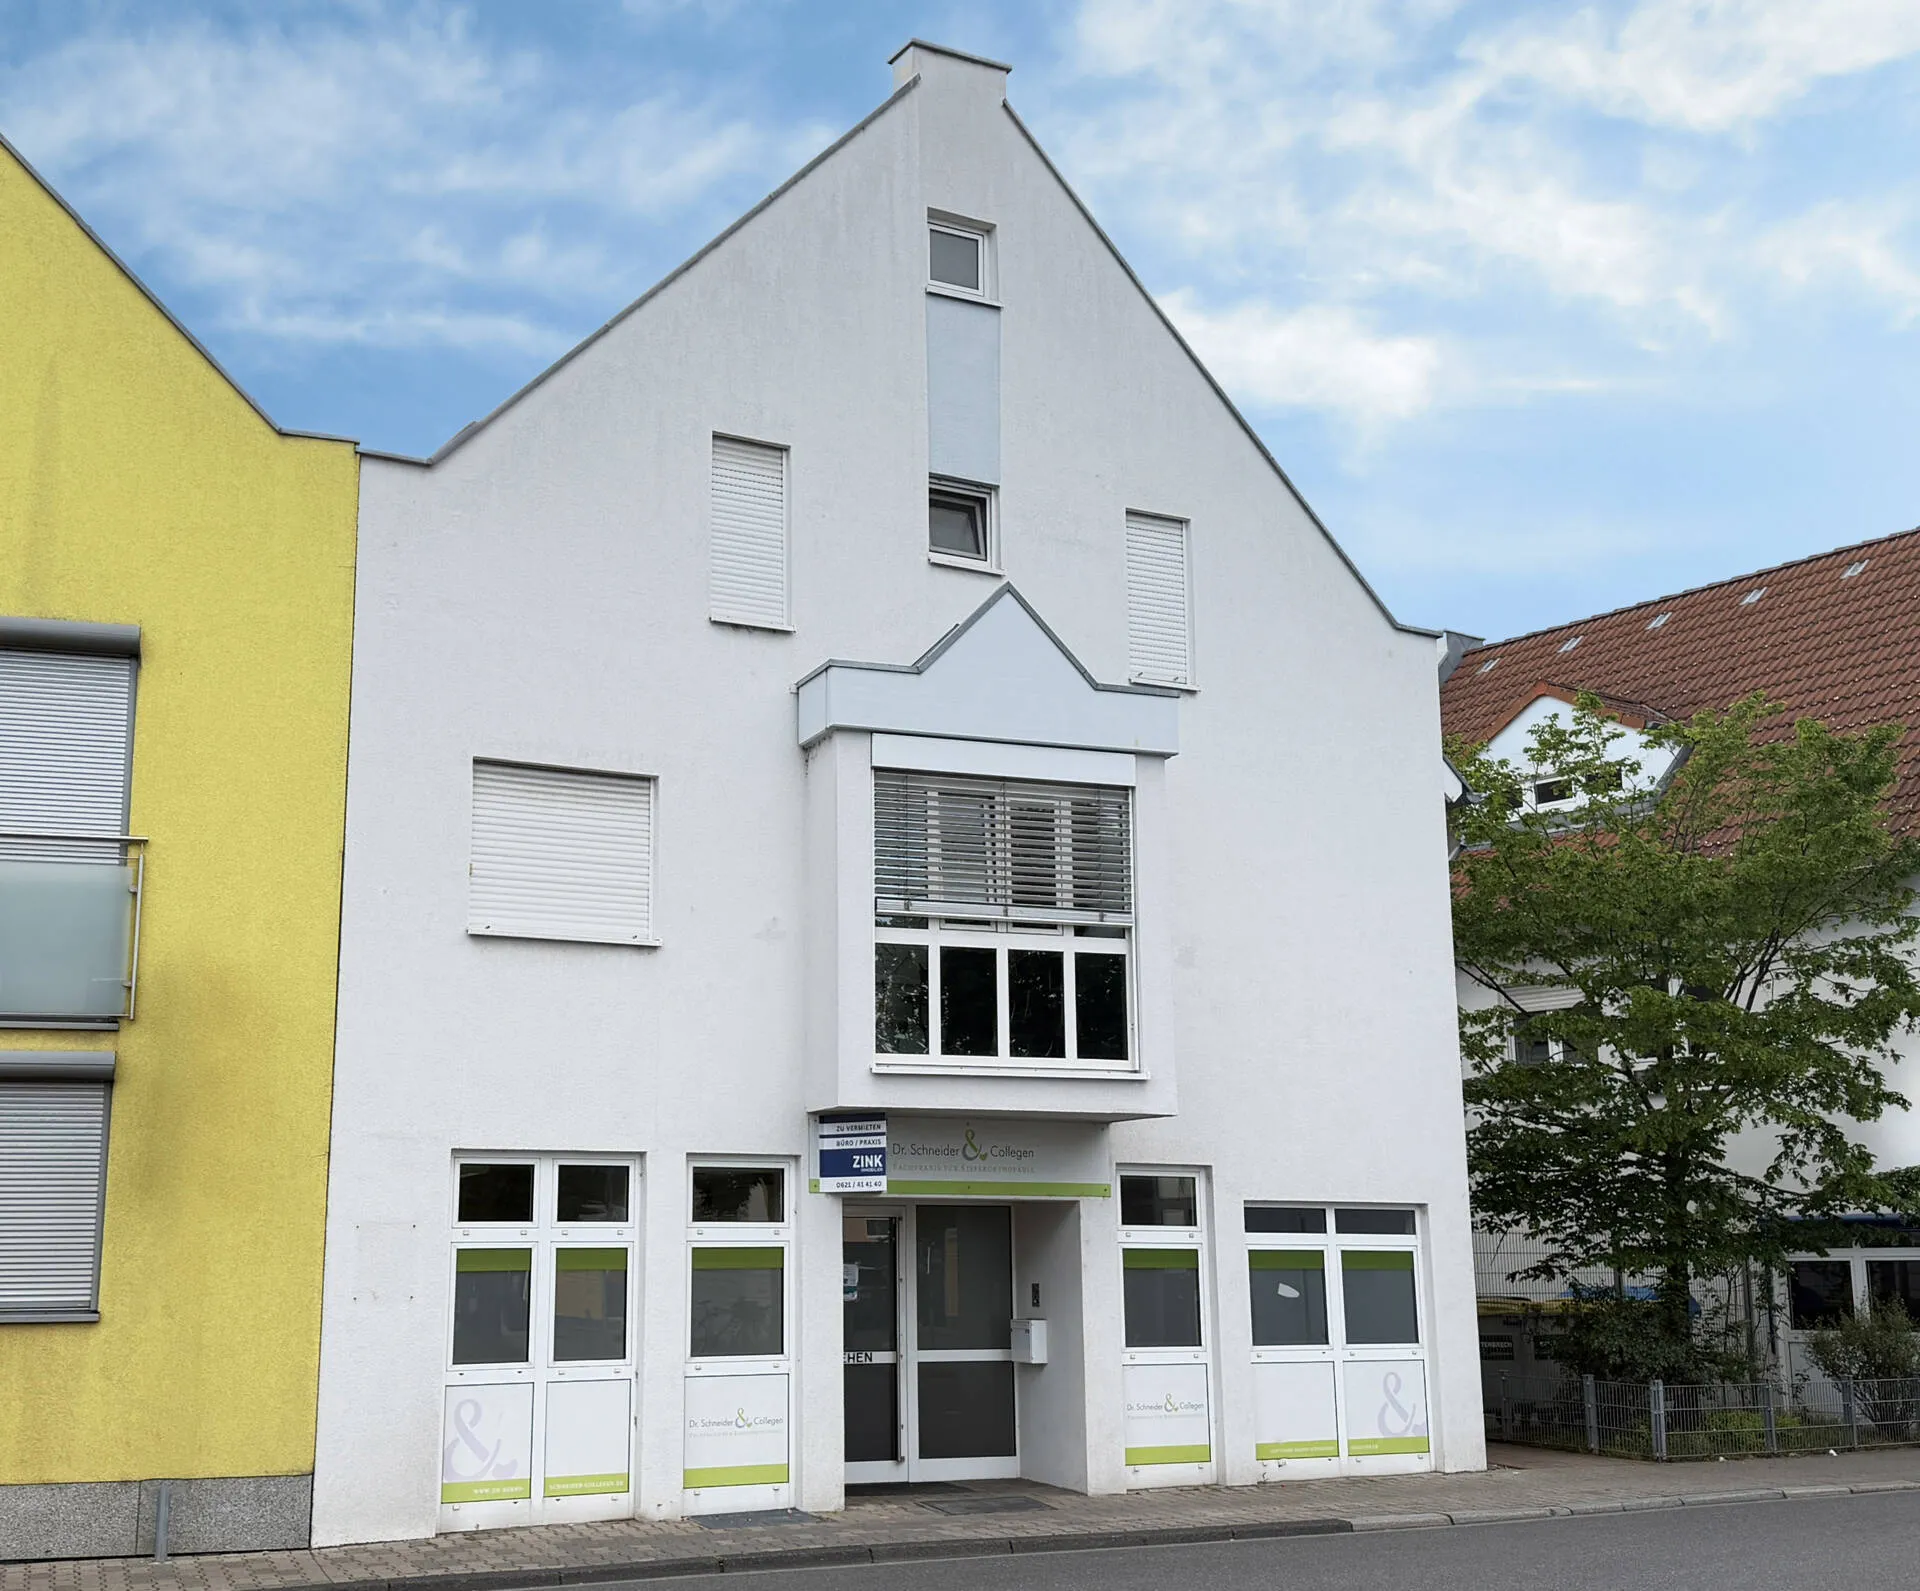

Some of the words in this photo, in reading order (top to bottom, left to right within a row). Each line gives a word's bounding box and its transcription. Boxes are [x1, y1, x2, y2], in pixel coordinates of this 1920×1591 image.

[846, 1123, 881, 1132] VERMIETEN
[836, 1139, 854, 1147] BÜRO
[860, 1138, 882, 1146] PRAXIS
[892, 1143, 906, 1156] Dr.
[910, 1143, 960, 1157] Schneider
[990, 1144, 1035, 1161] Collegen
[852, 1154, 883, 1169] ZINK
[701, 1418, 733, 1428] Schneider
